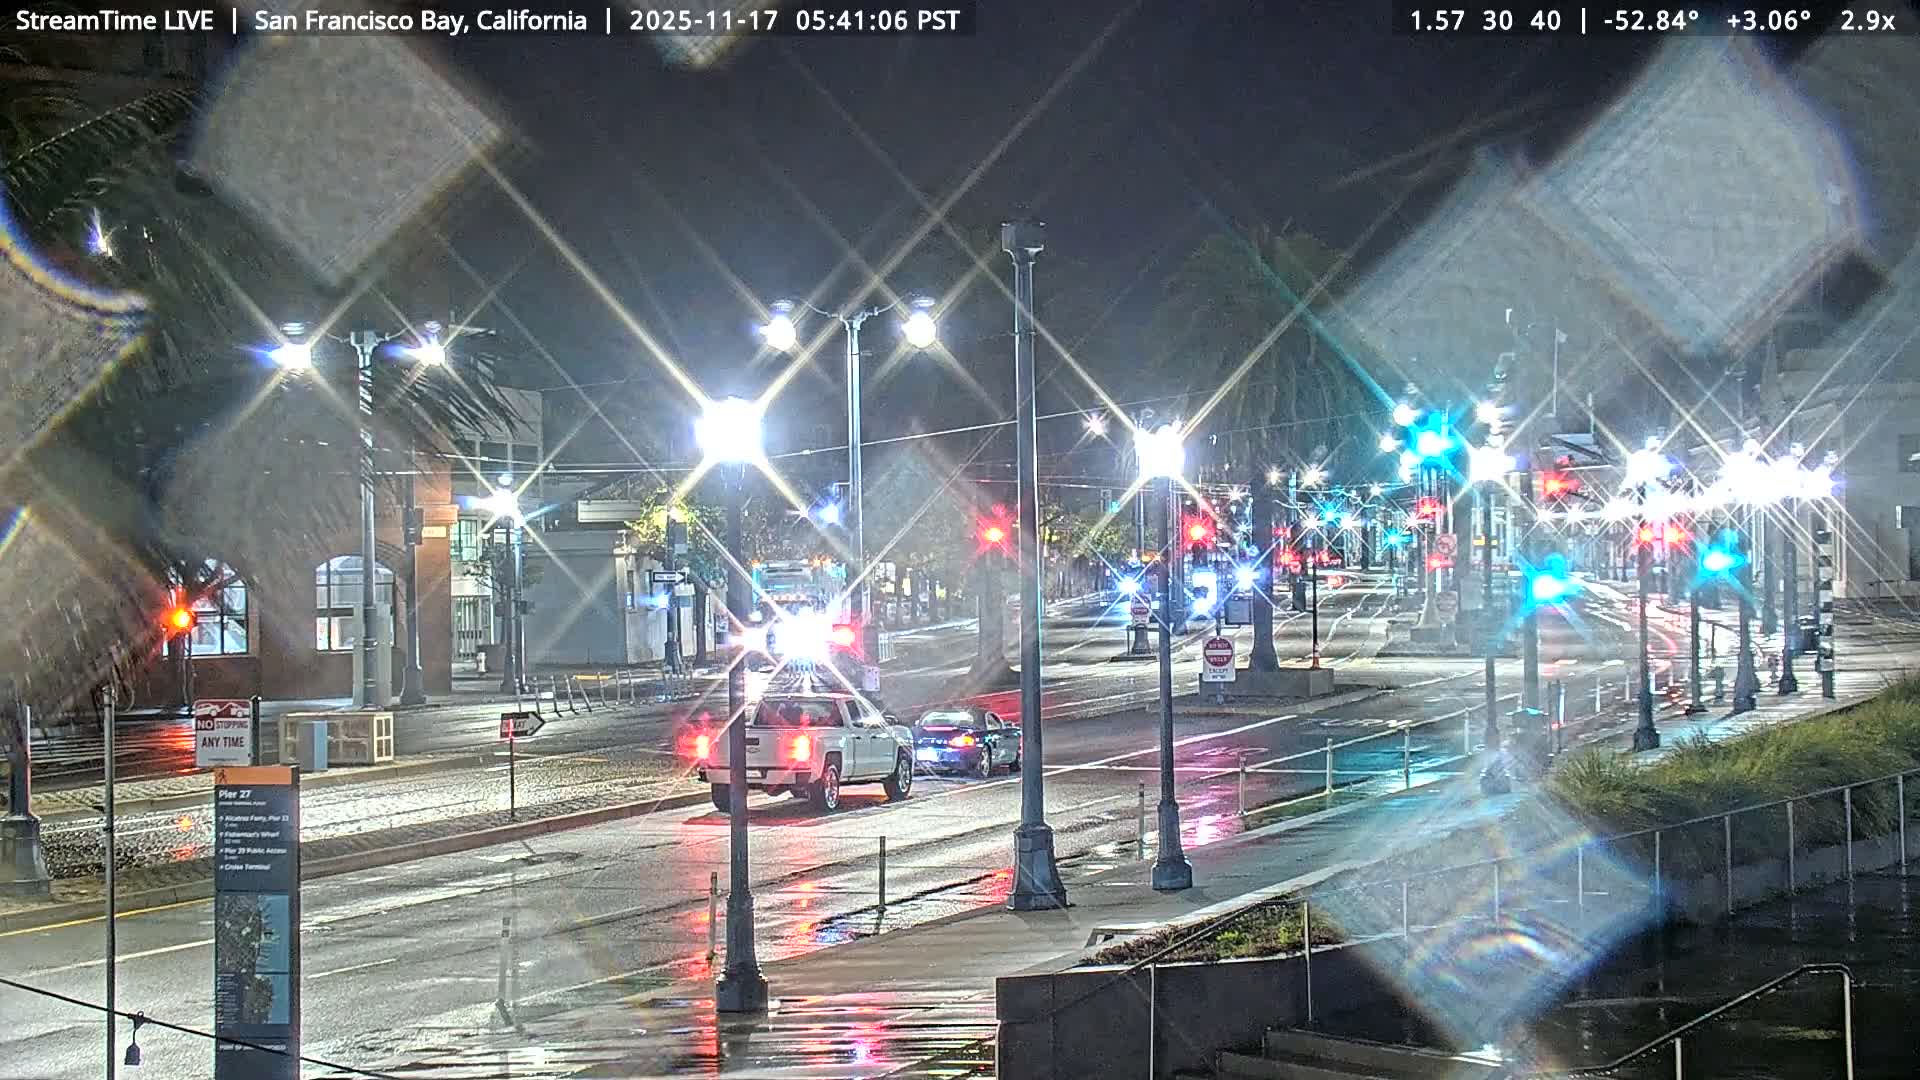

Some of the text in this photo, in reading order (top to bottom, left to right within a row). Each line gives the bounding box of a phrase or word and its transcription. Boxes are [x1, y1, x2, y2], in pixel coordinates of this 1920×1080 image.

[197, 719, 249, 729] NO STOPPING
[201, 736, 245, 748] ANY TIME
[218, 789, 252, 799] Pier 27
